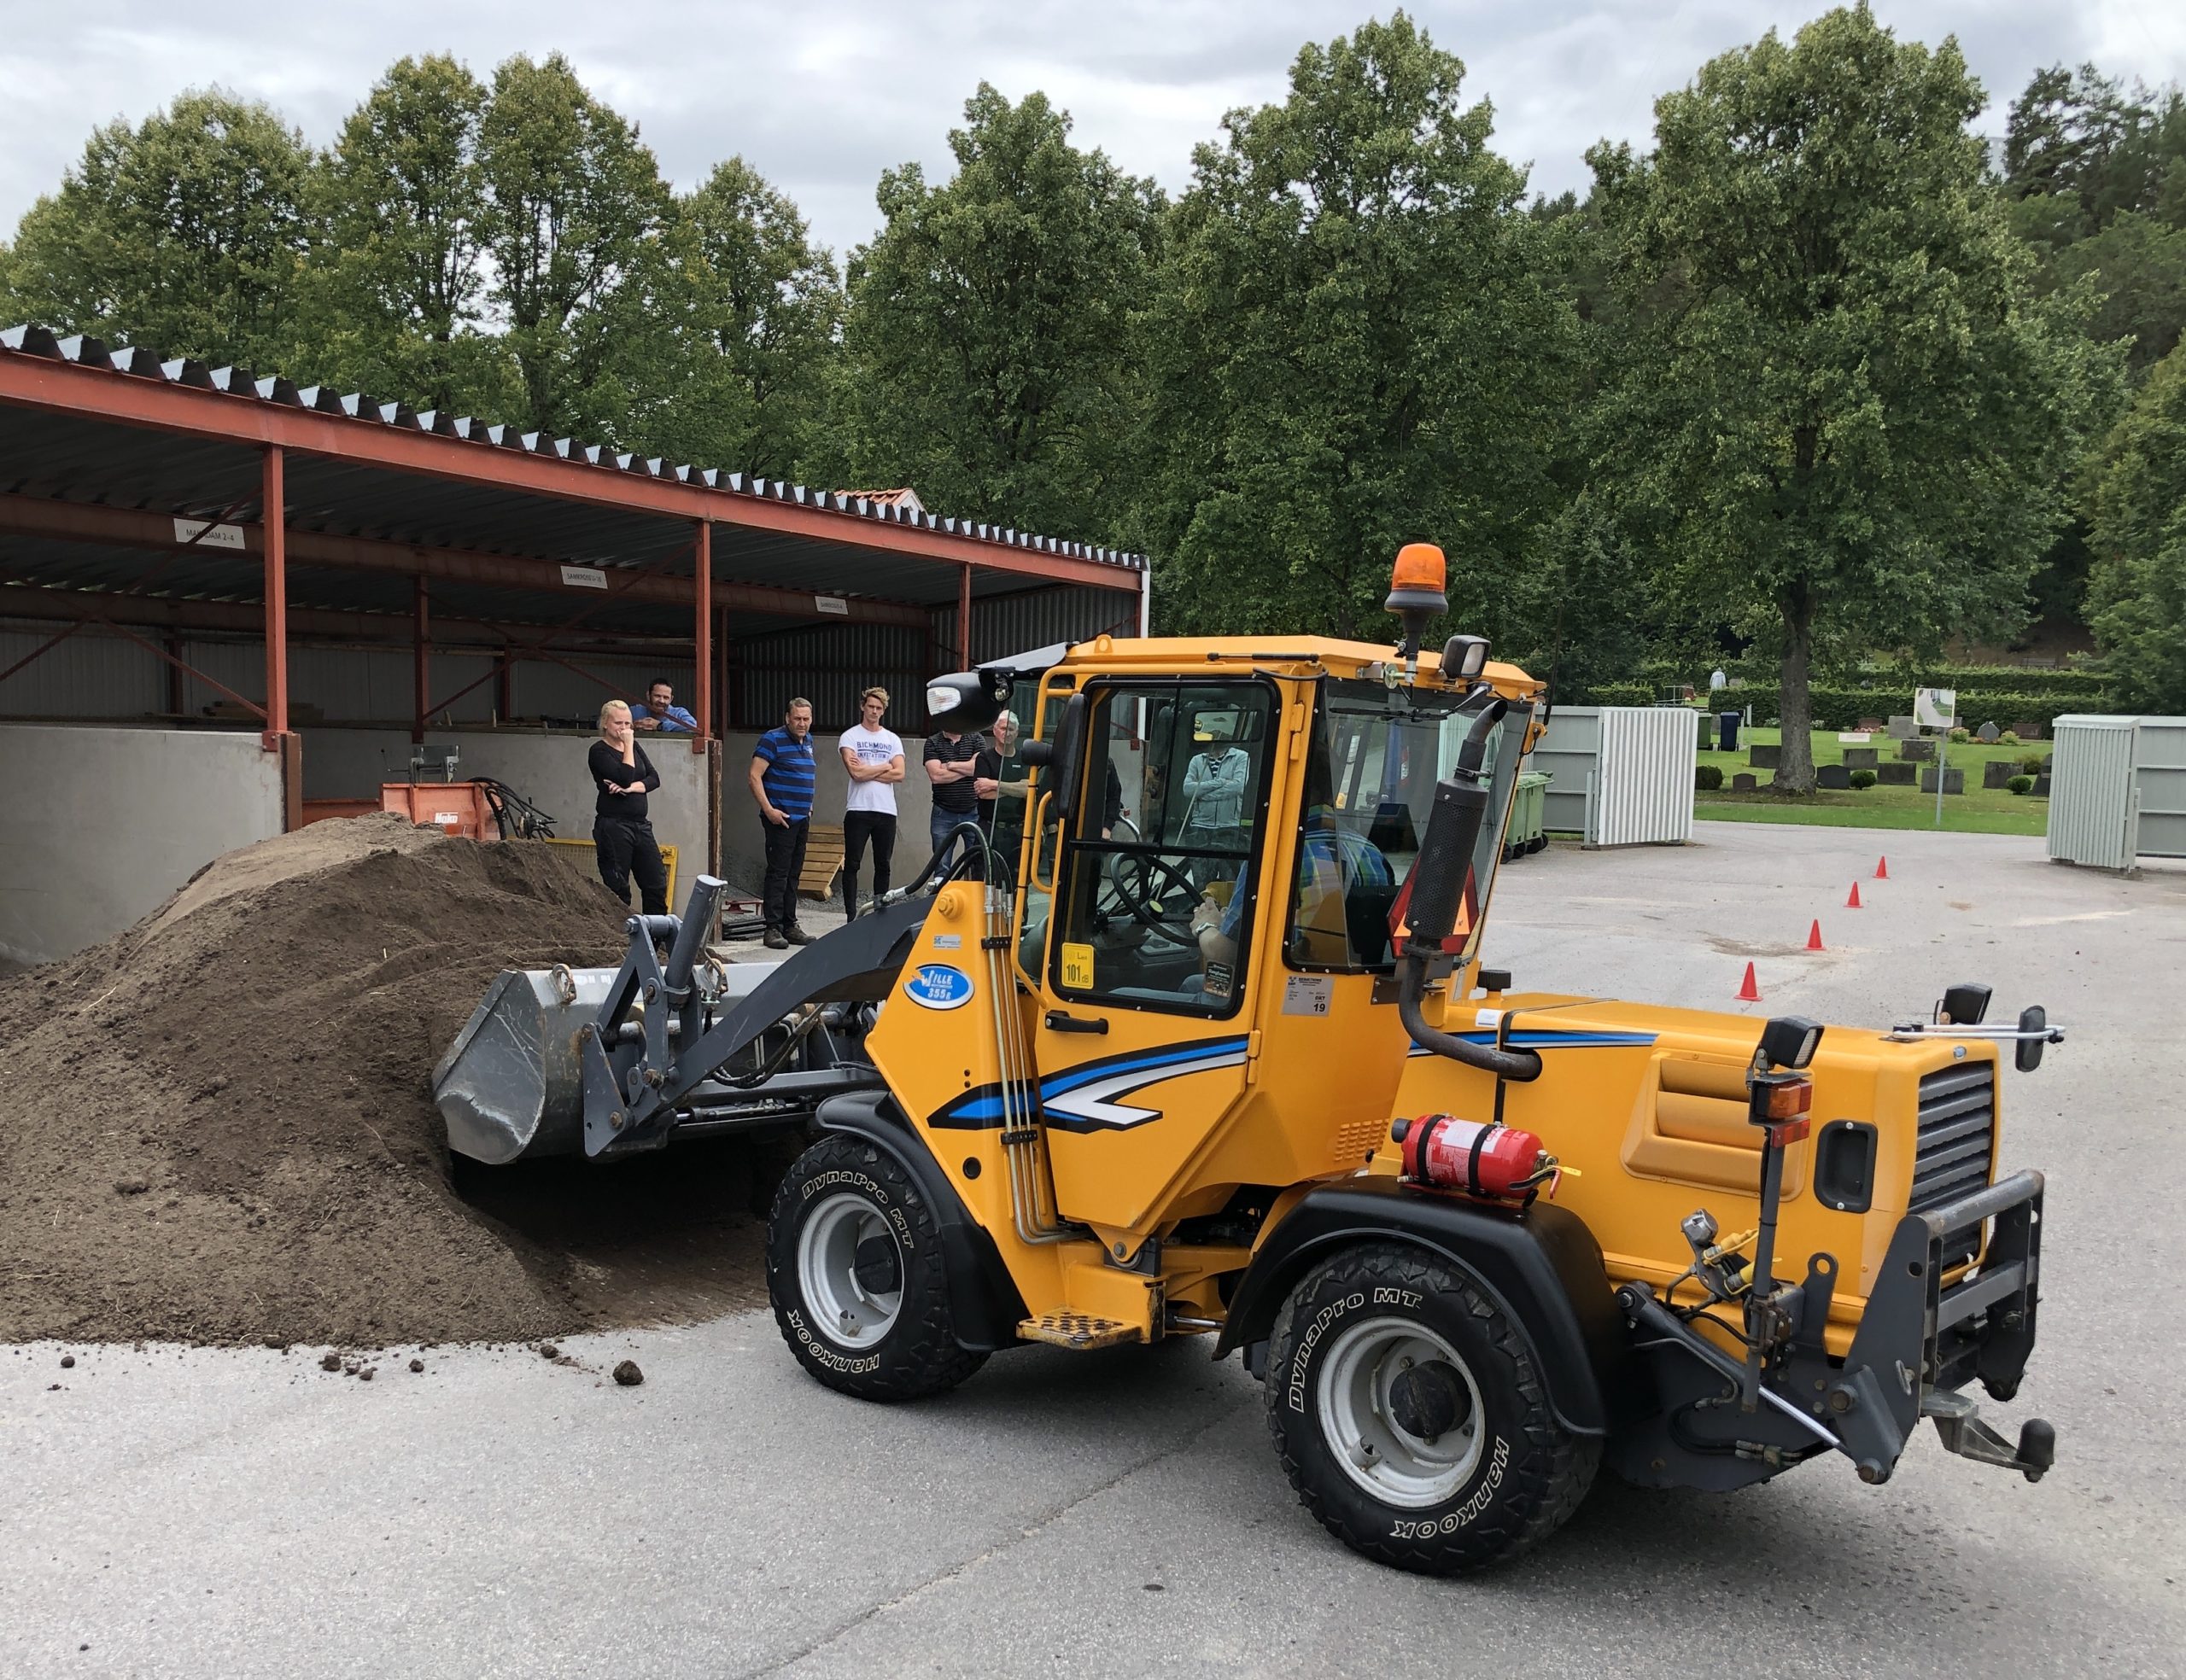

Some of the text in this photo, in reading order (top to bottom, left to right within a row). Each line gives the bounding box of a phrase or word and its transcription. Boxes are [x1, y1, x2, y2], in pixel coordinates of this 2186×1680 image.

[1067, 964, 1081, 983] 101
[1313, 1003, 1325, 1012] 19
[890, 1208, 915, 1249] MT
[1373, 1287, 1423, 1309] MT
